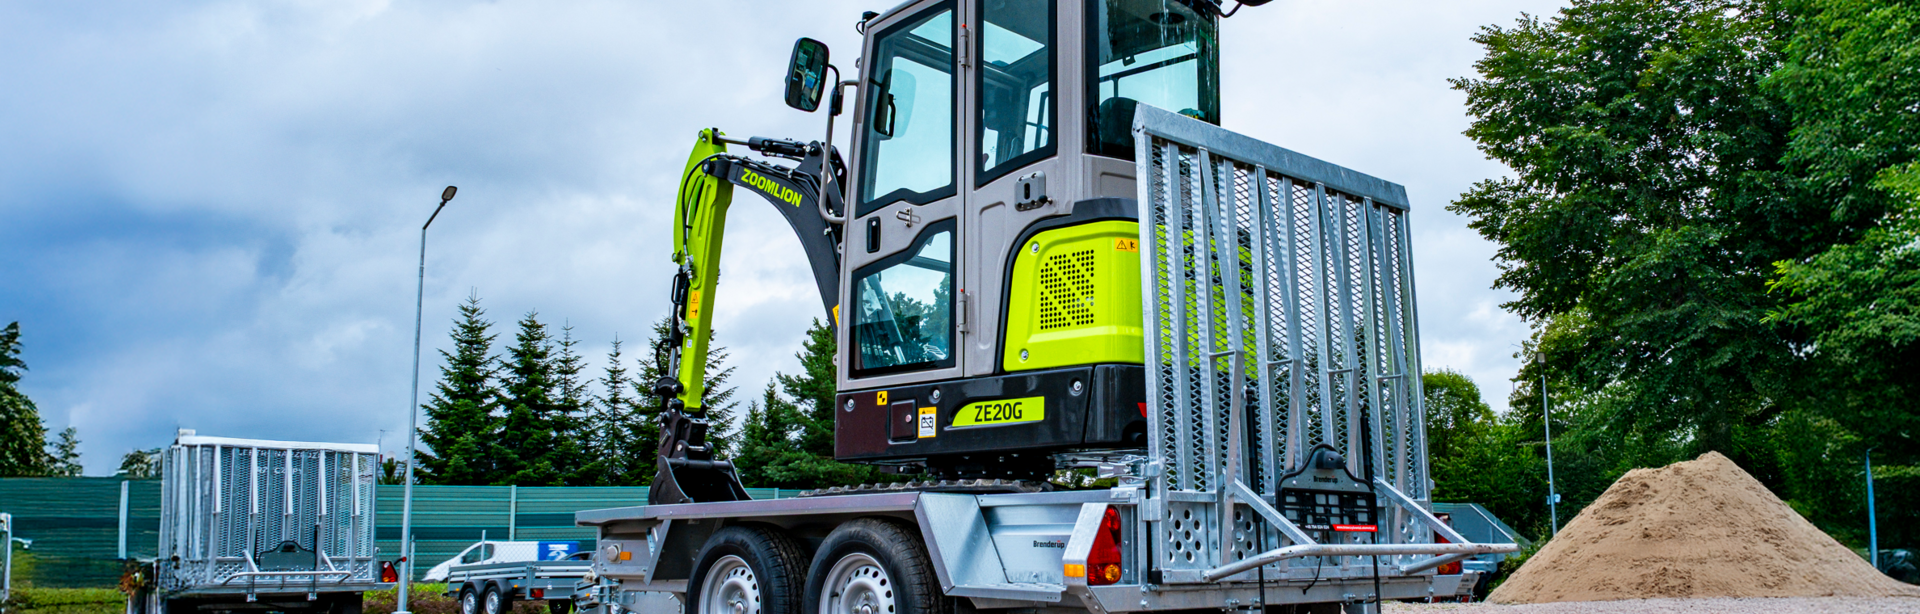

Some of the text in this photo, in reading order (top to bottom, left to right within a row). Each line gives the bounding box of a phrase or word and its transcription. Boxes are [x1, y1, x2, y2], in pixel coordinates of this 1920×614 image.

[741, 168, 803, 207] ZOOMLION
[974, 402, 1023, 422] ZE20G
[1033, 540, 1065, 550] Brenderup
